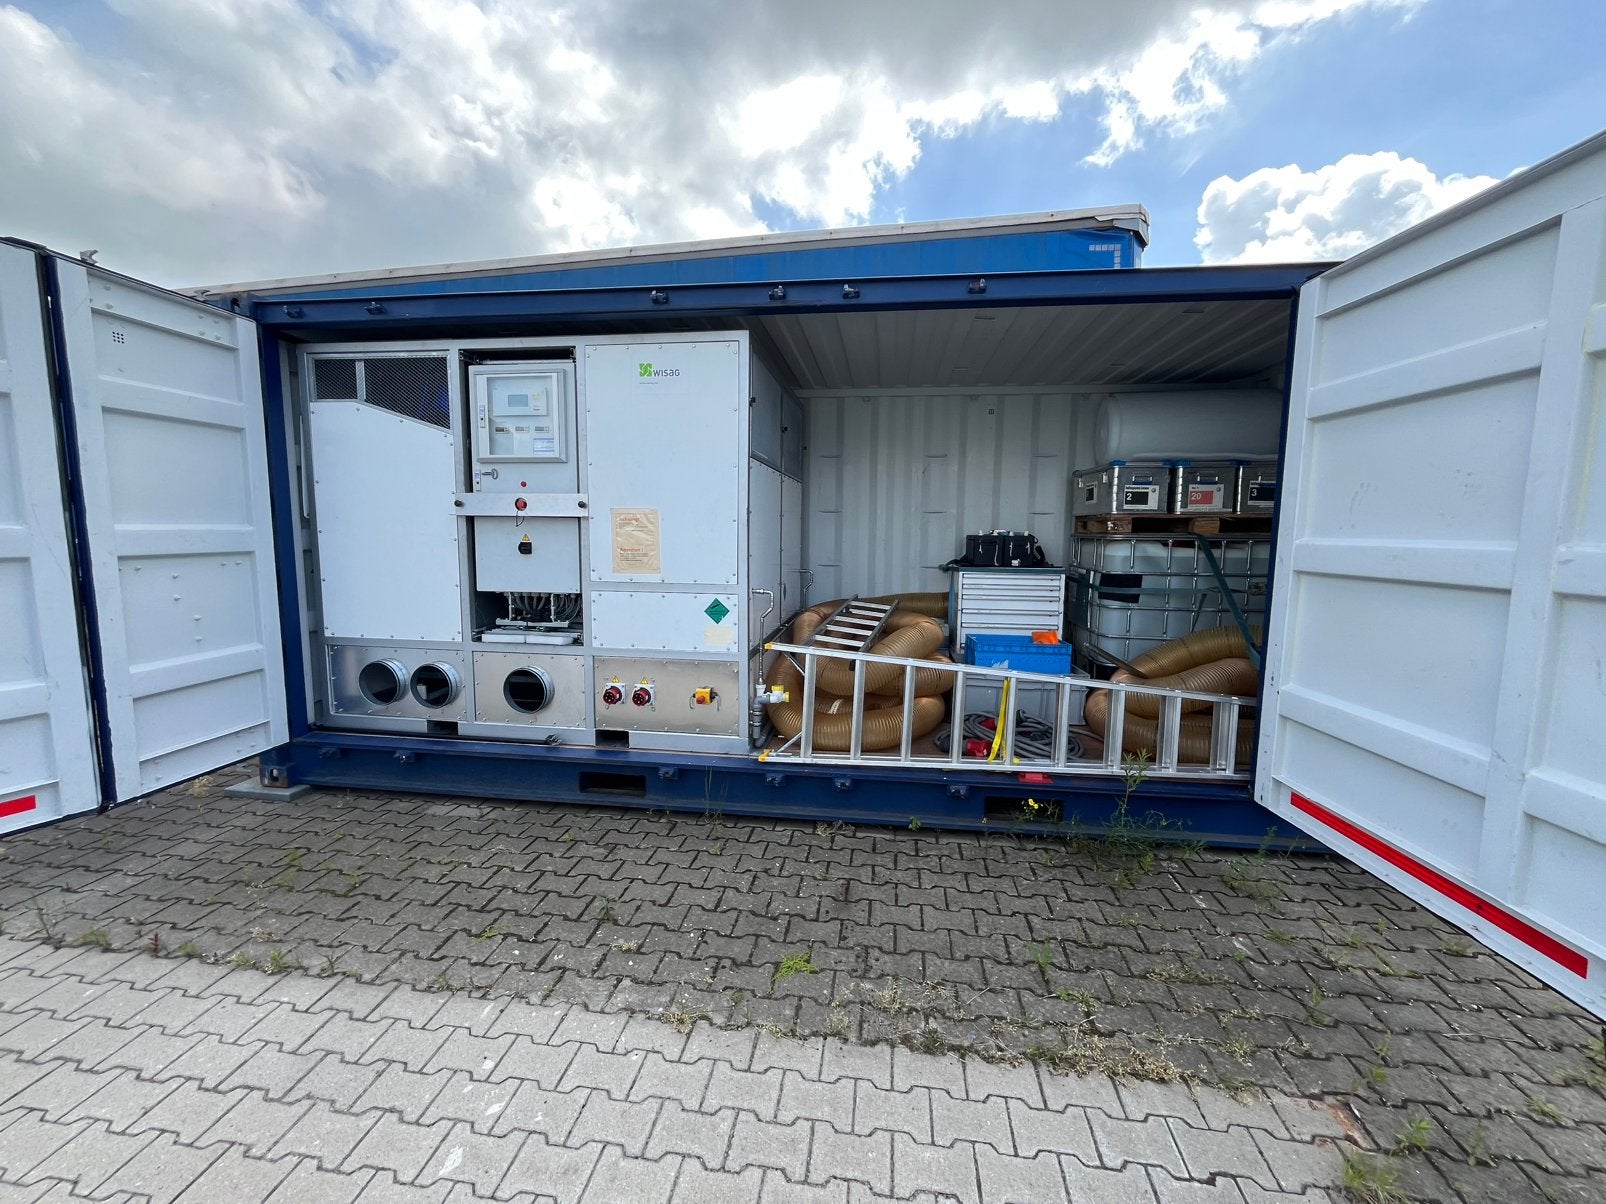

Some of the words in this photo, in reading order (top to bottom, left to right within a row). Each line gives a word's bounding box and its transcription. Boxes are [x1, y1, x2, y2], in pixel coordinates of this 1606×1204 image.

[1126, 492, 1132, 501] 2
[1191, 492, 1202, 500] 20
[1251, 488, 1257, 497] 3
